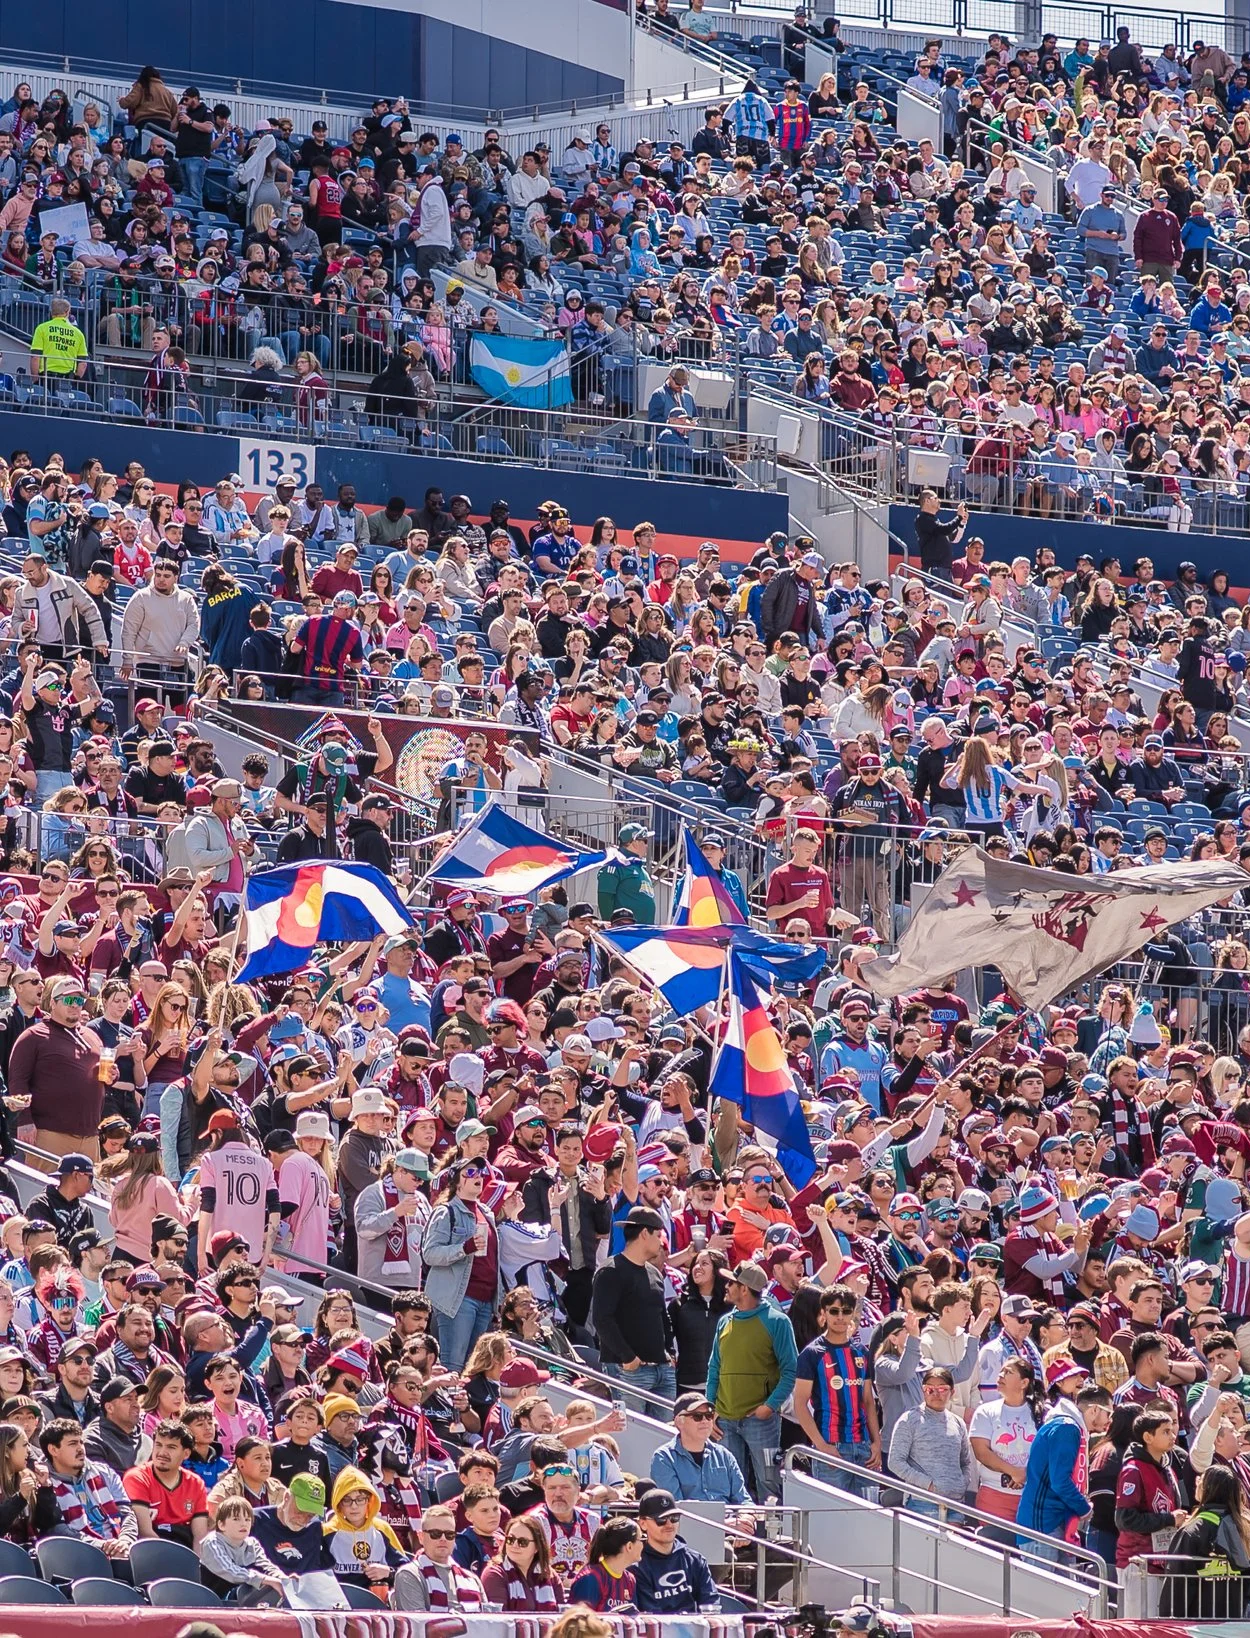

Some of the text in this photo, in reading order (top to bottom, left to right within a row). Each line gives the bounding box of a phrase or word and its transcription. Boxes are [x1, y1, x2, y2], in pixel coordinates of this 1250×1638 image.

[742, 105, 760, 122] 10
[327, 189, 341, 205] 23
[49, 326, 74, 337] argus
[49, 335, 76, 347] RESPONSE
[55, 343, 69, 352] TEAM
[247, 448, 309, 492] 133
[208, 586, 242, 607] BARÇA
[1199, 656, 1215, 680] 10
[226, 1154, 257, 1166] MESSI
[223, 1170, 260, 1206] 10
[311, 1171, 331, 1209] 10
[335, 1562, 361, 1573] DENVER
